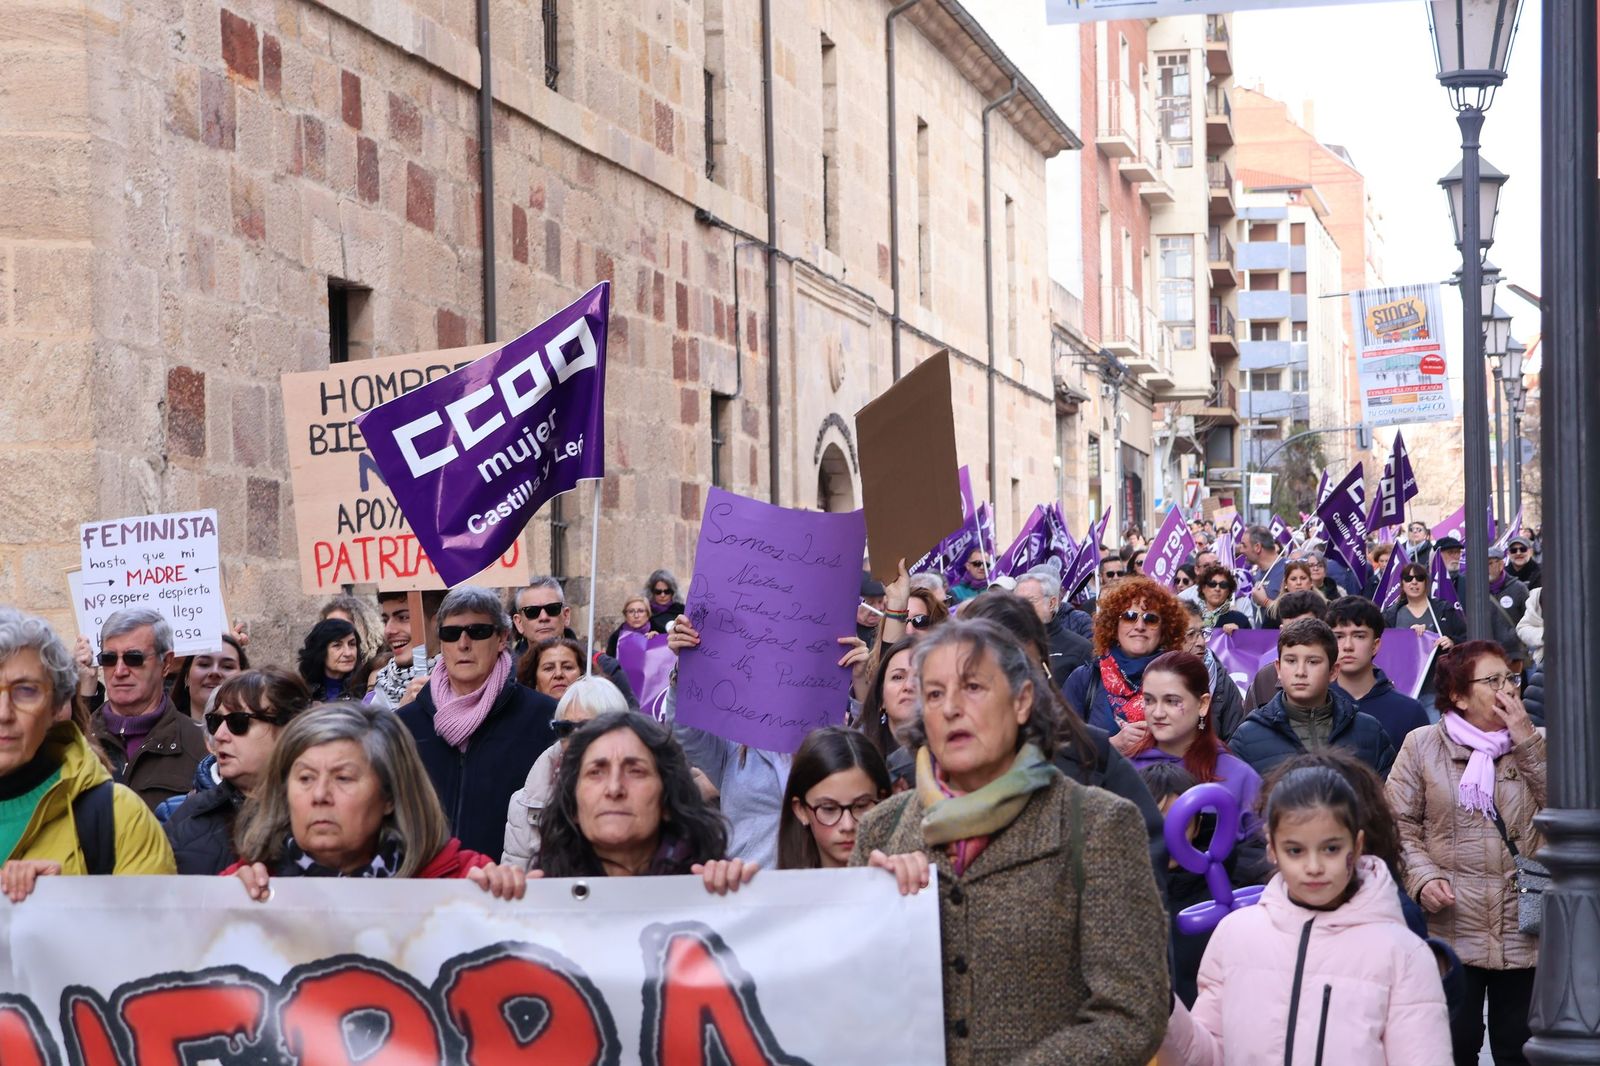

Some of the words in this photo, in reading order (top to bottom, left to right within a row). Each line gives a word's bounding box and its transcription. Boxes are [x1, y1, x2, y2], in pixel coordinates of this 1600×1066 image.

[1372, 299, 1419, 325] STOCK
[320, 360, 476, 416] HOMB
[392, 316, 597, 479] CCOO
[309, 420, 369, 456] BIE
[477, 408, 556, 484] mujer
[467, 477, 541, 535] Castilla
[554, 433, 584, 464] Leó
[83, 516, 217, 549] FEMINISTA
[337, 496, 412, 535] APOY
[707, 503, 785, 561] Somos
[1332, 512, 1351, 540] Castilla
[90, 555, 126, 569] hasta
[143, 551, 165, 565] que
[181, 548, 195, 559] mi
[126, 564, 188, 587] MADRE
[313, 534, 520, 588] PATRIAO
[110, 591, 150, 608] espere
[158, 583, 211, 601] despierta
[173, 604, 203, 621] llego
[174, 628, 202, 639] asa
